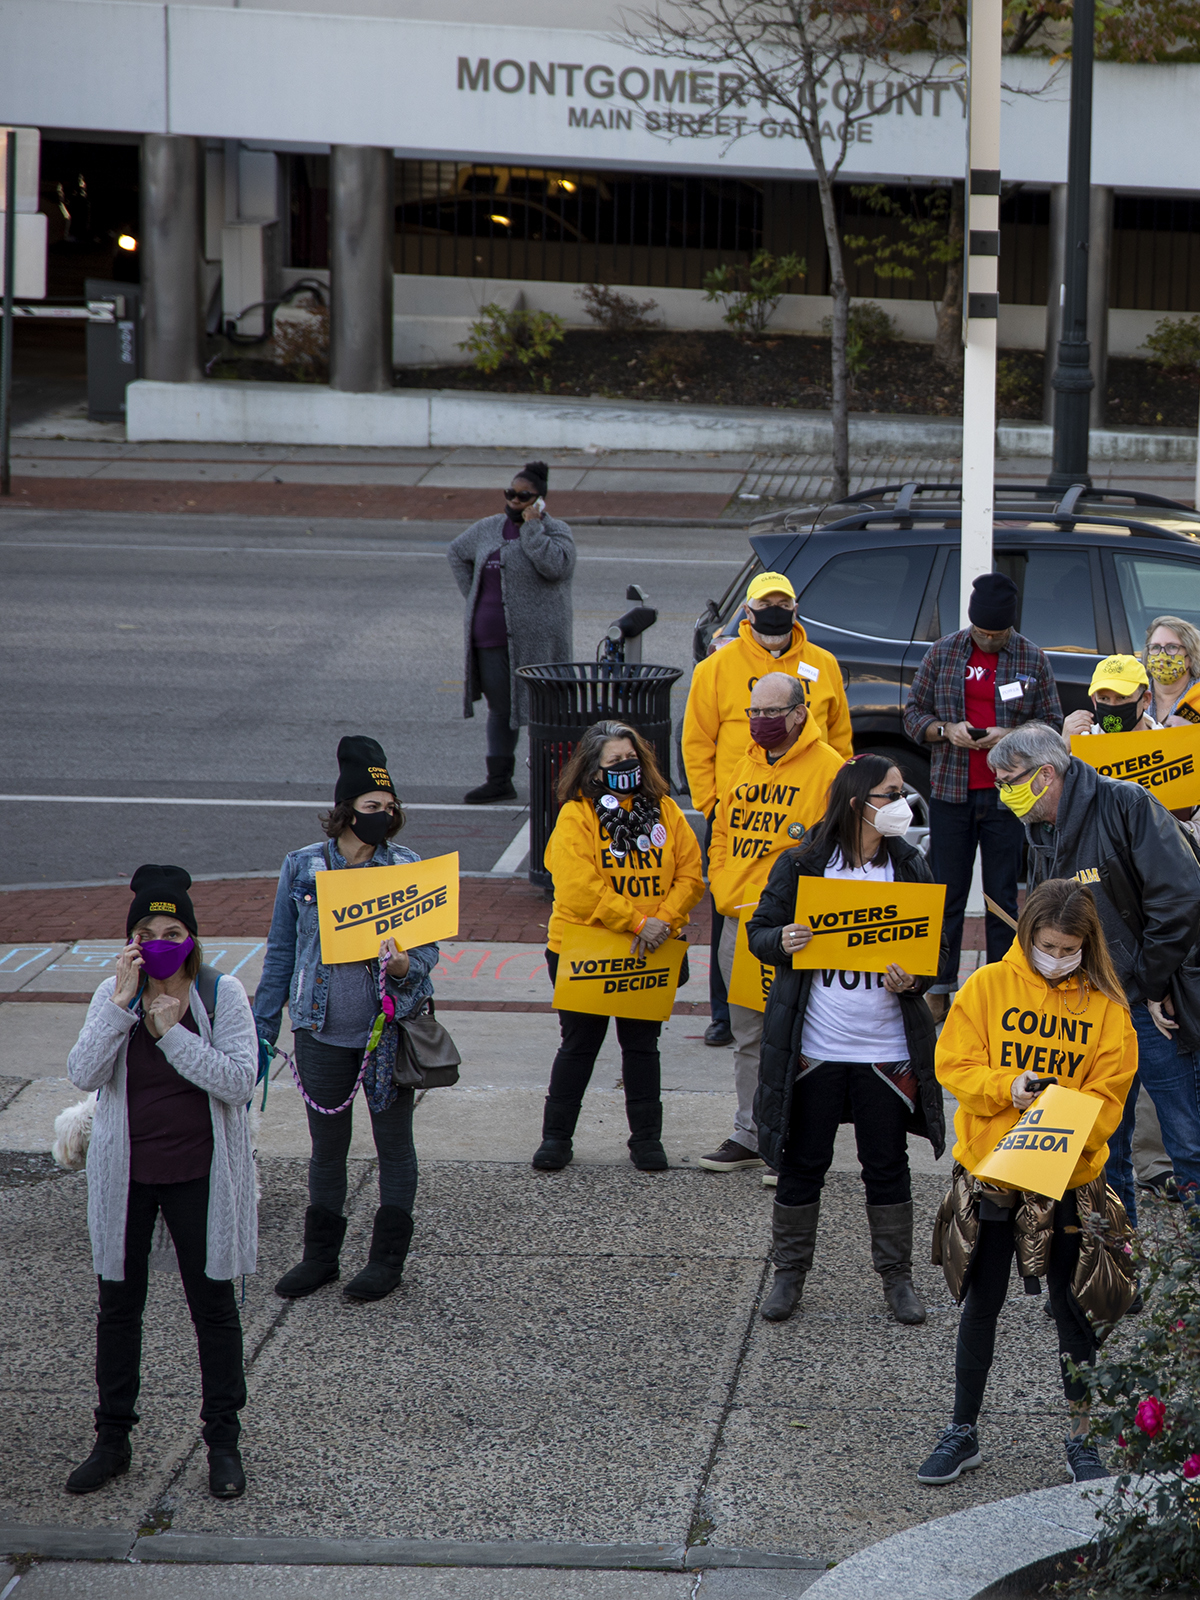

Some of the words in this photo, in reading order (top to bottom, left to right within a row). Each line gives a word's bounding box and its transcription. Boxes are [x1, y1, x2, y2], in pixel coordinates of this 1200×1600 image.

[568, 106, 632, 130] MAIN
[645, 111, 748, 136] STREET
[760, 117, 873, 143] GAAGE
[1094, 750, 1165, 777] OTERS
[1130, 760, 1195, 790] ECIDE
[607, 769, 641, 790] VOTE
[735, 783, 800, 807] COUNT
[729, 807, 787, 834] EVERY
[331, 883, 419, 924] VOTERS
[375, 890, 448, 935] DECIDE
[808, 904, 898, 929] VOTERS
[847, 922, 929, 947] DECIDE
[570, 956, 647, 975] VOTERS
[603, 973, 669, 994] DECIDE
[1001, 1006, 1093, 1045] COUNT
[1000, 1040, 1085, 1078] EVERY
[993, 1133, 1069, 1153] VOTERS
